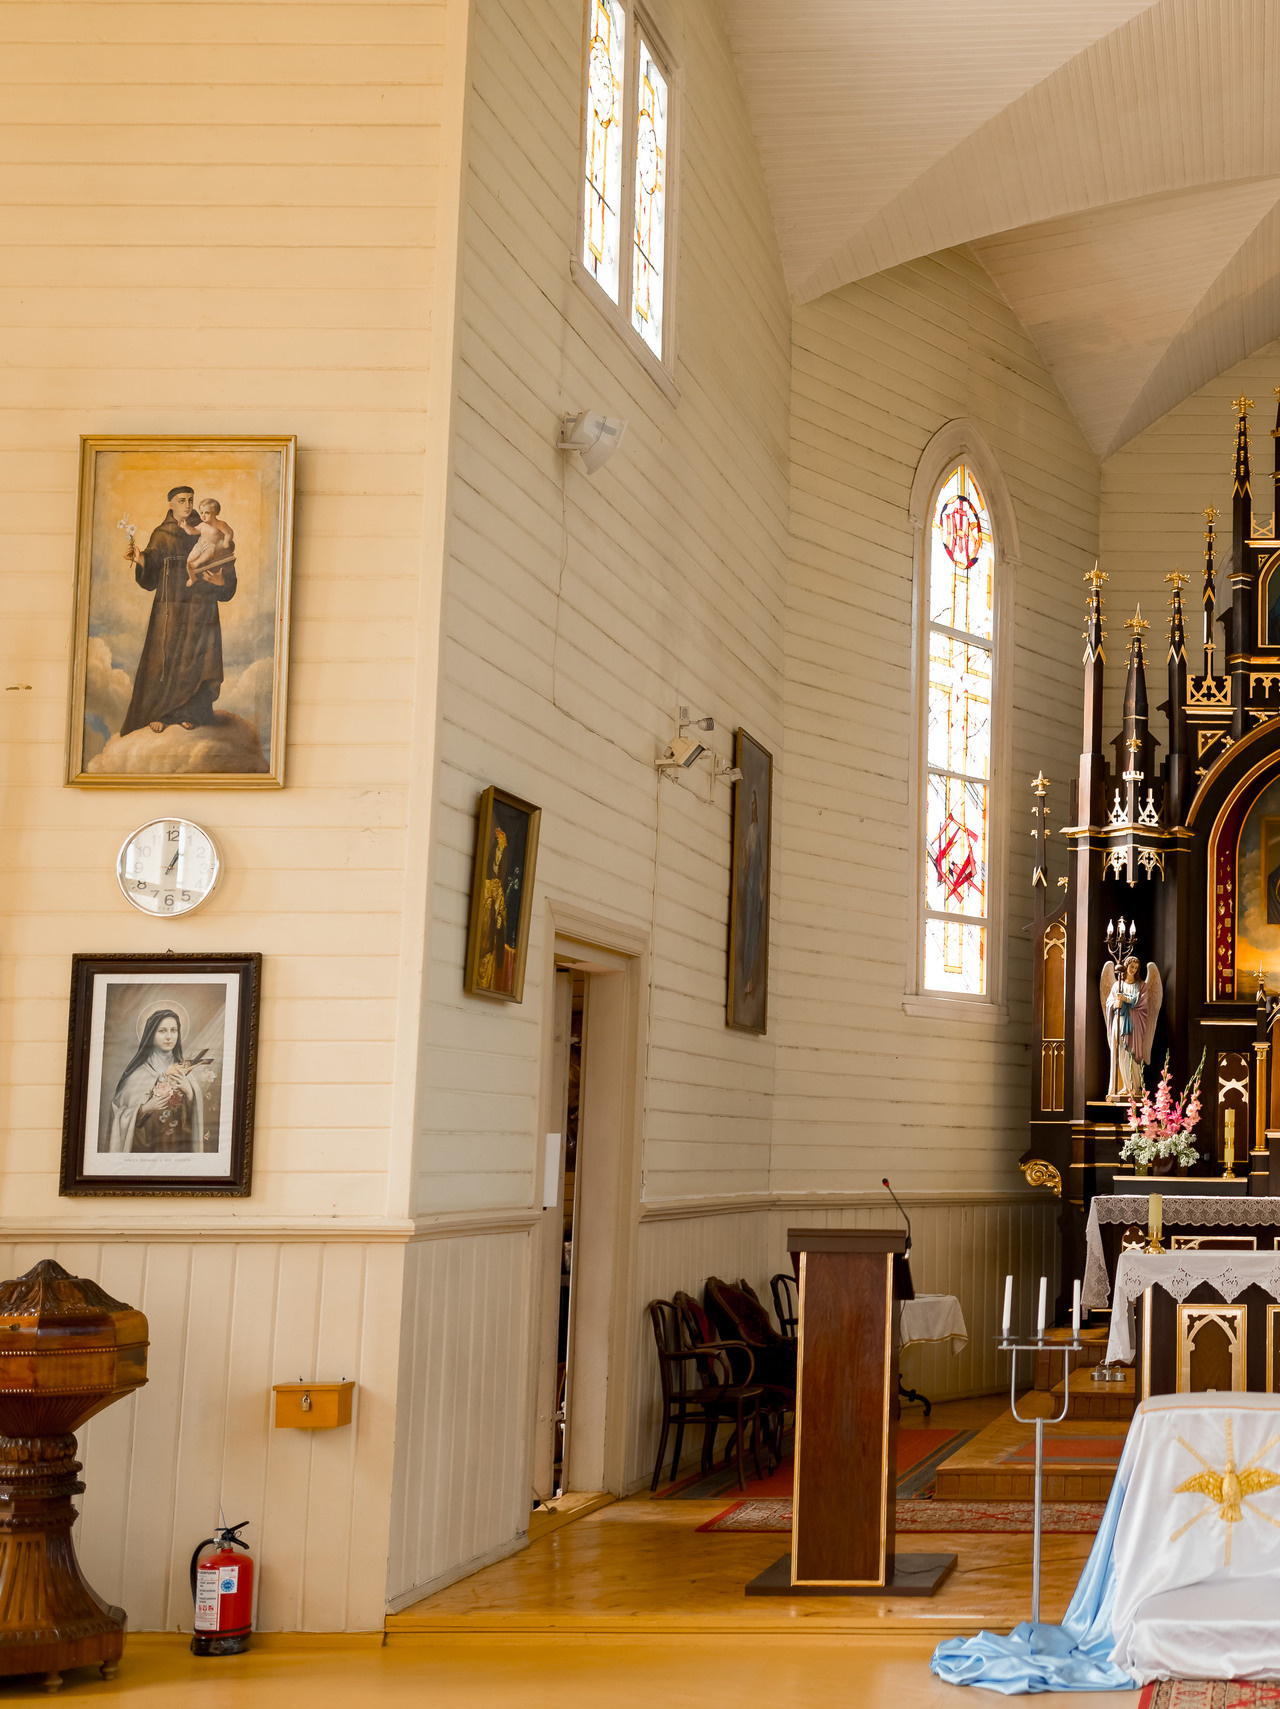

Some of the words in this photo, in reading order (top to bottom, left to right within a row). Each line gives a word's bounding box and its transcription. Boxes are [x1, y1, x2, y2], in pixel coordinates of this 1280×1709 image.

[166, 829, 180, 842] 12
[136, 845, 152, 858] 10
[196, 846, 205, 858] 2
[134, 861, 144, 874] 9
[150, 889, 160, 899] 7
[164, 894, 175, 907] 6
[181, 889, 191, 902] 5
